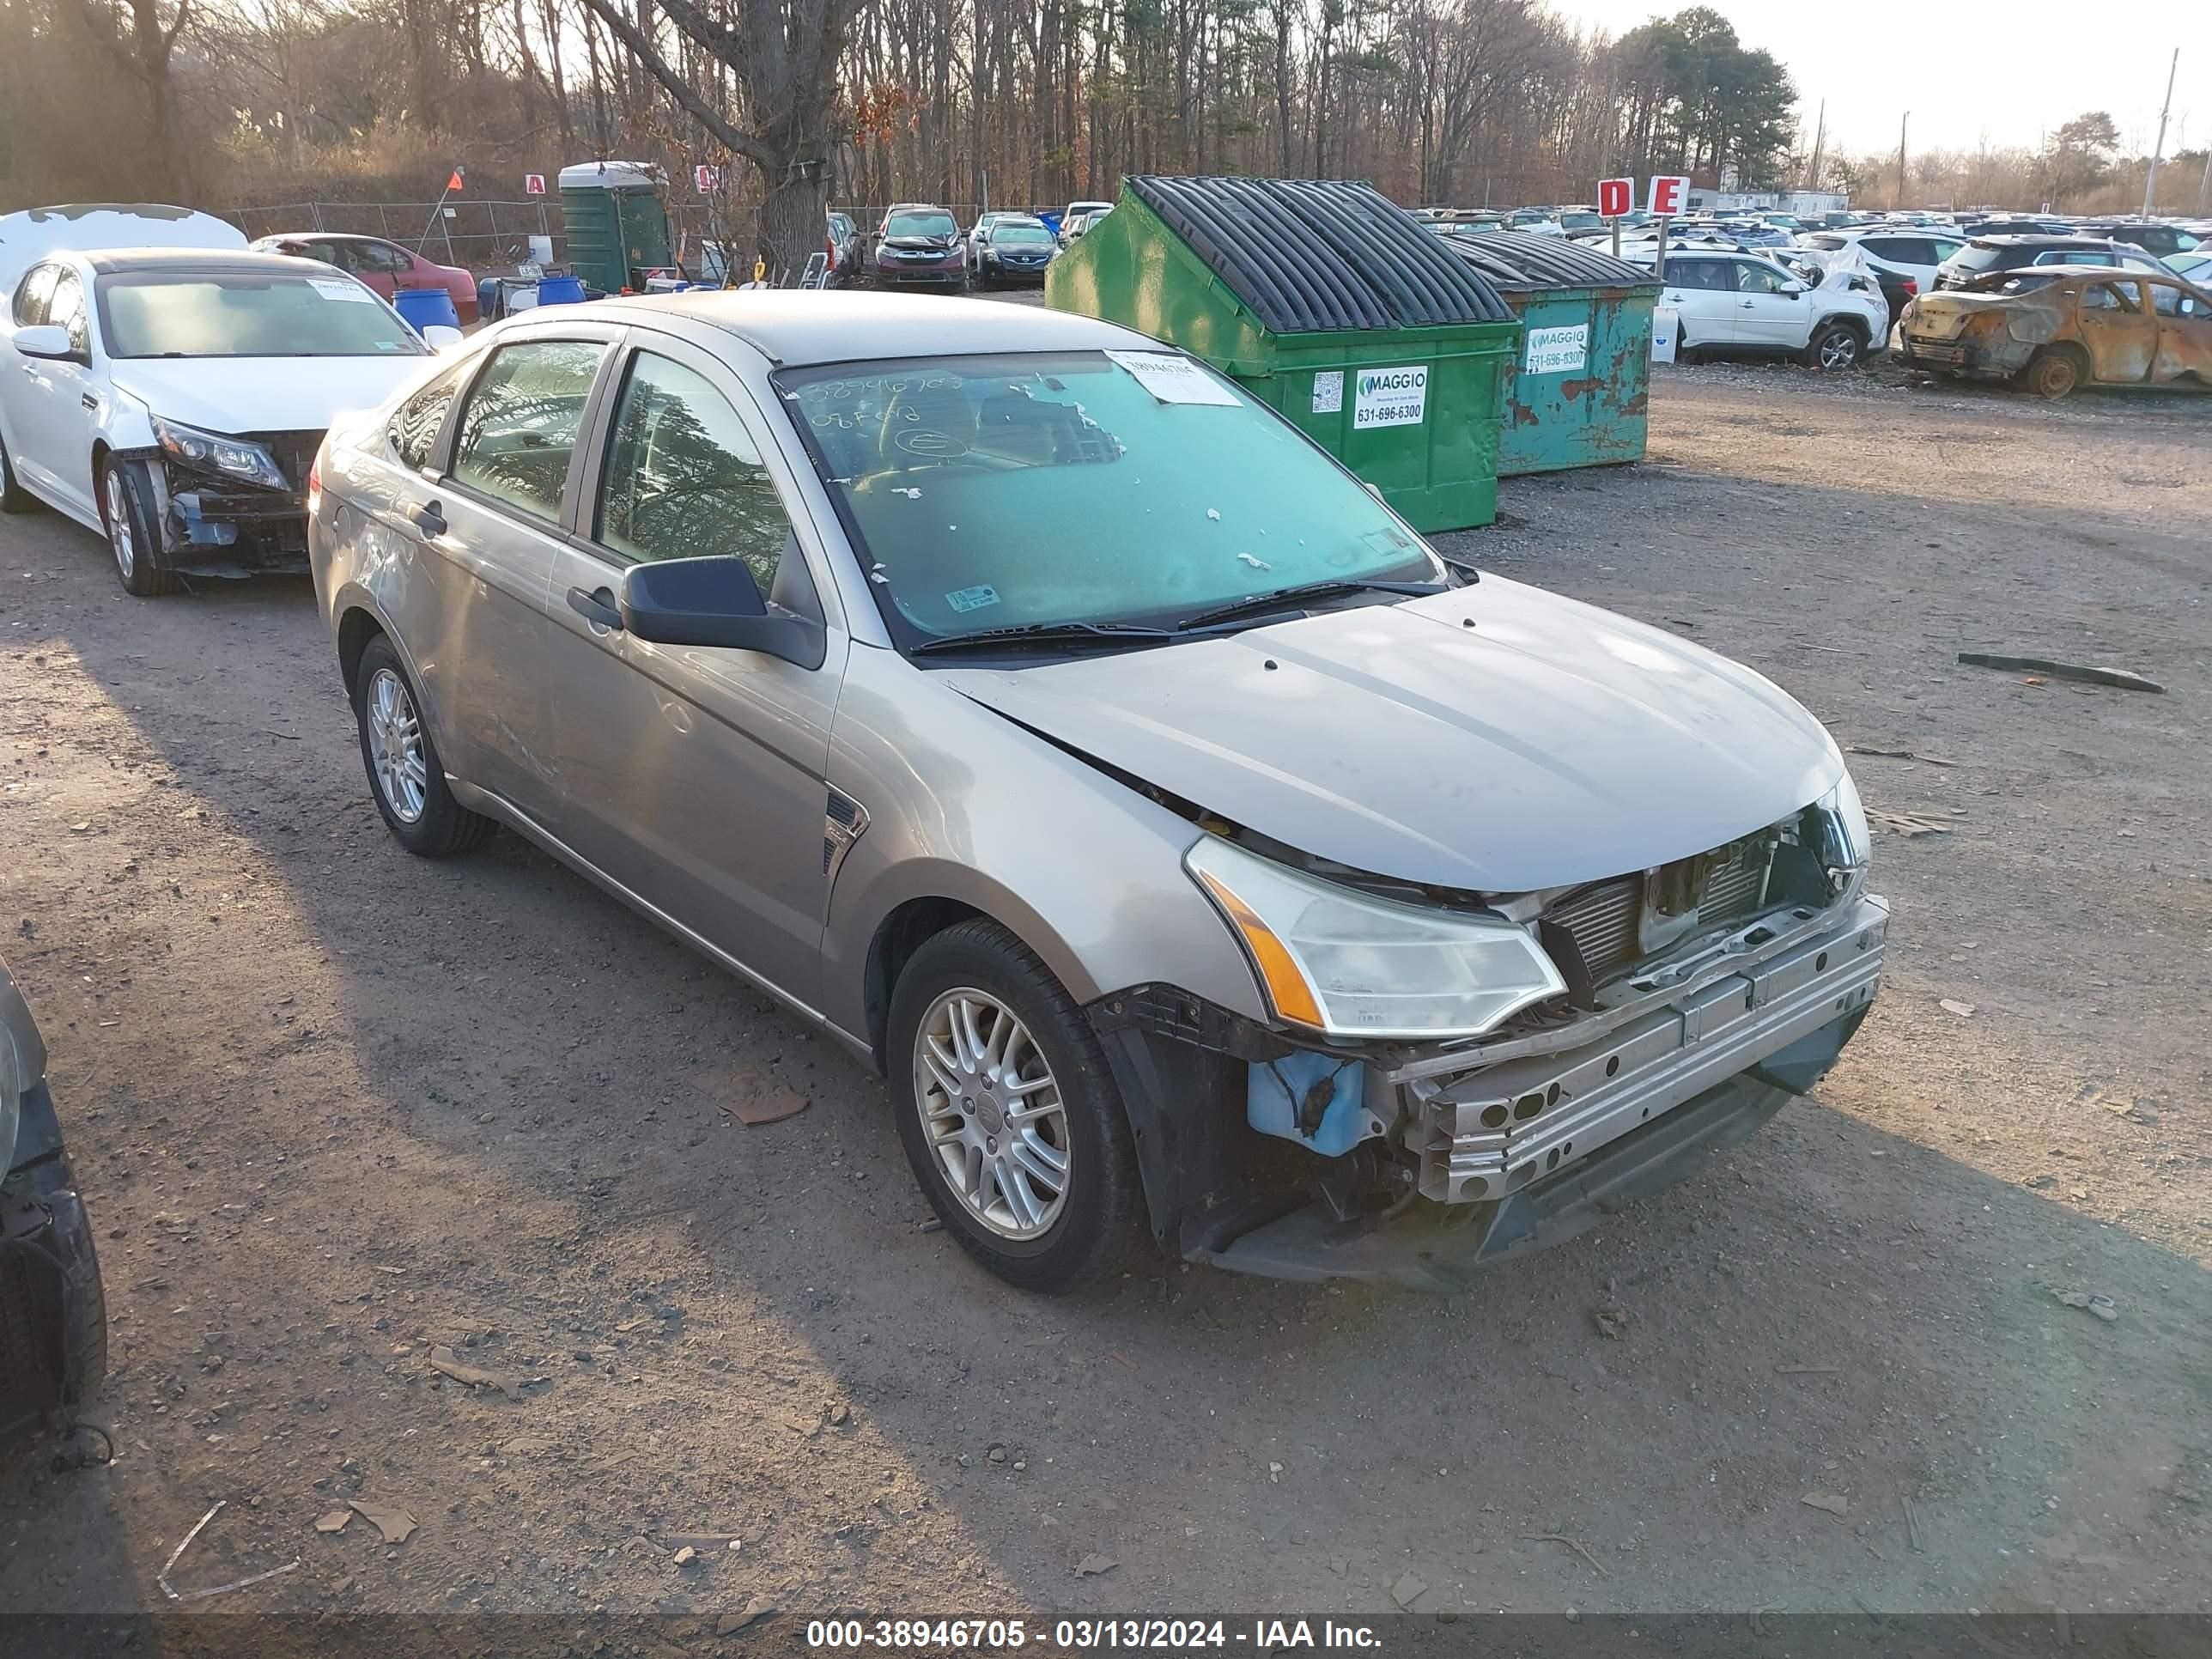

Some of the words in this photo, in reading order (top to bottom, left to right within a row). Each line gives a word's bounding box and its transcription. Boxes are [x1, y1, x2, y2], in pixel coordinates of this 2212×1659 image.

[528, 176, 544, 192] A
[1600, 181, 1630, 216] D
[1654, 179, 1680, 213] E
[1540, 331, 1584, 344] MAGGIO
[1529, 350, 1583, 368] 631-696-6300
[1370, 373, 1425, 391] MAGGIO
[1358, 404, 1421, 422] 631-696-6300
